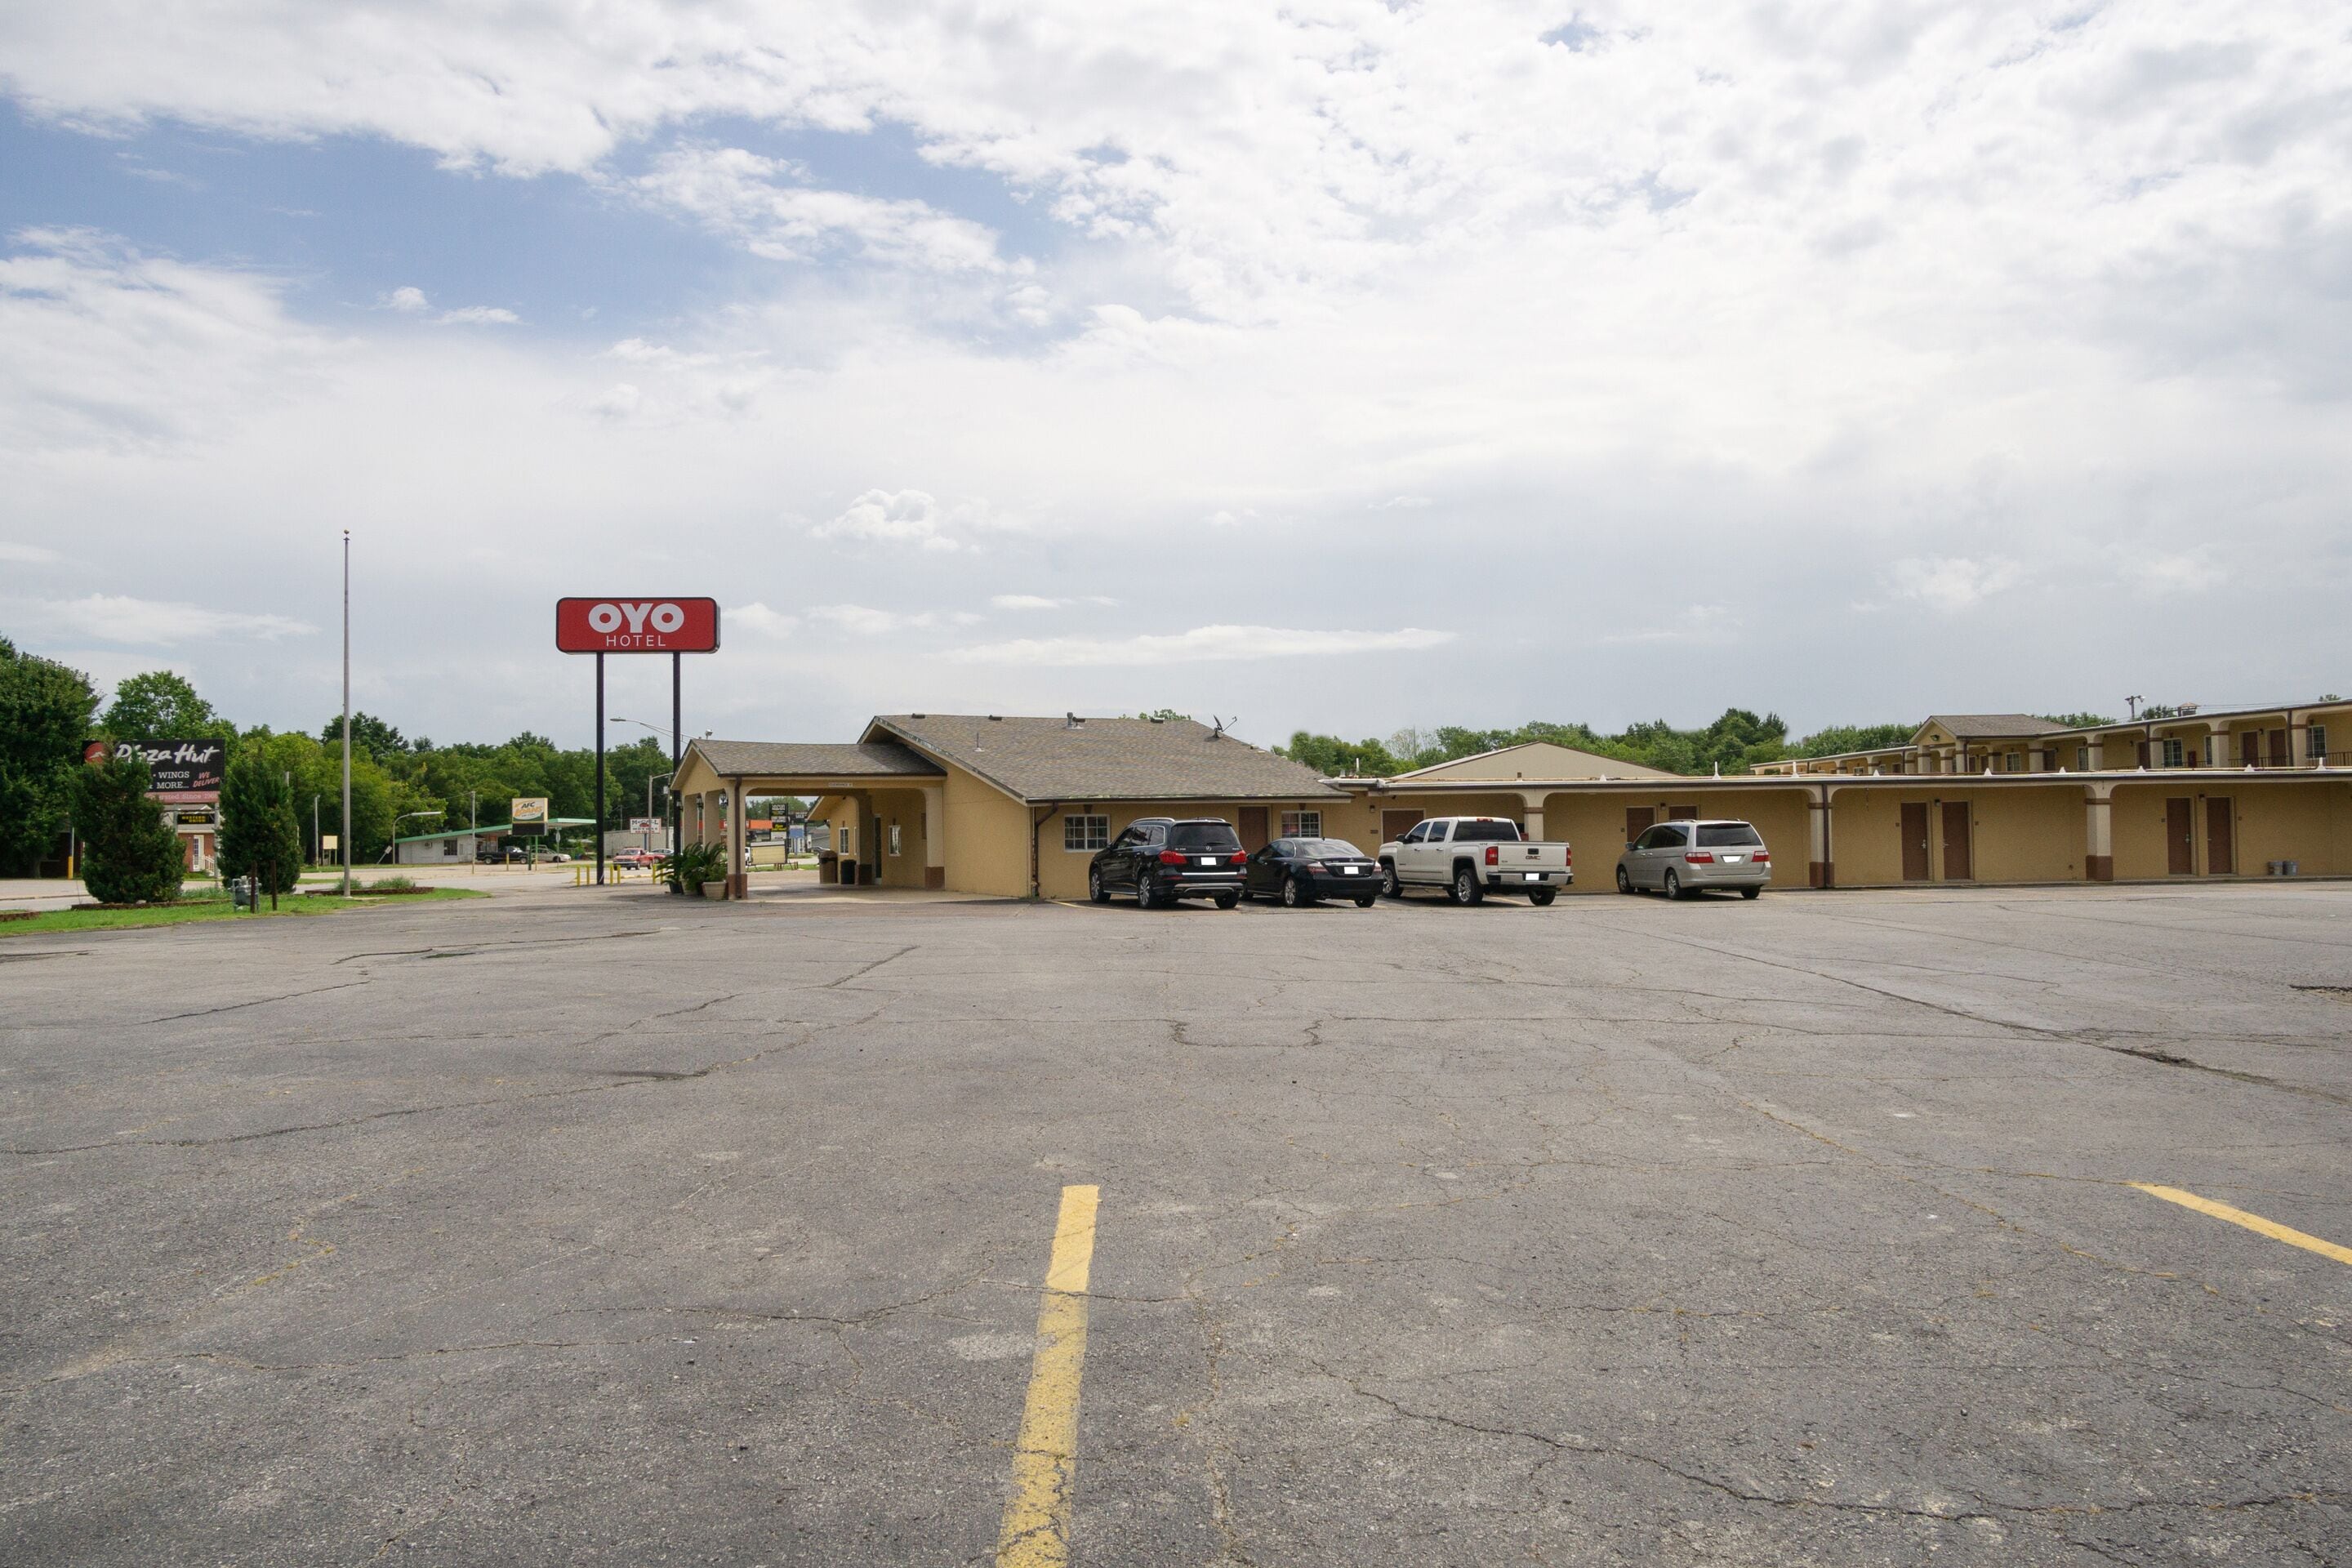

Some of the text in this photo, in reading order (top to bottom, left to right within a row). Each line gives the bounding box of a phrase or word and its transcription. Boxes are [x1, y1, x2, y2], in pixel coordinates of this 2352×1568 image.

[588, 603, 684, 634] OYO
[606, 635, 666, 647] HOTEL
[174, 743, 220, 764] Hut
[158, 771, 190, 779] WINGS
[192, 777, 220, 788] DELIVER
